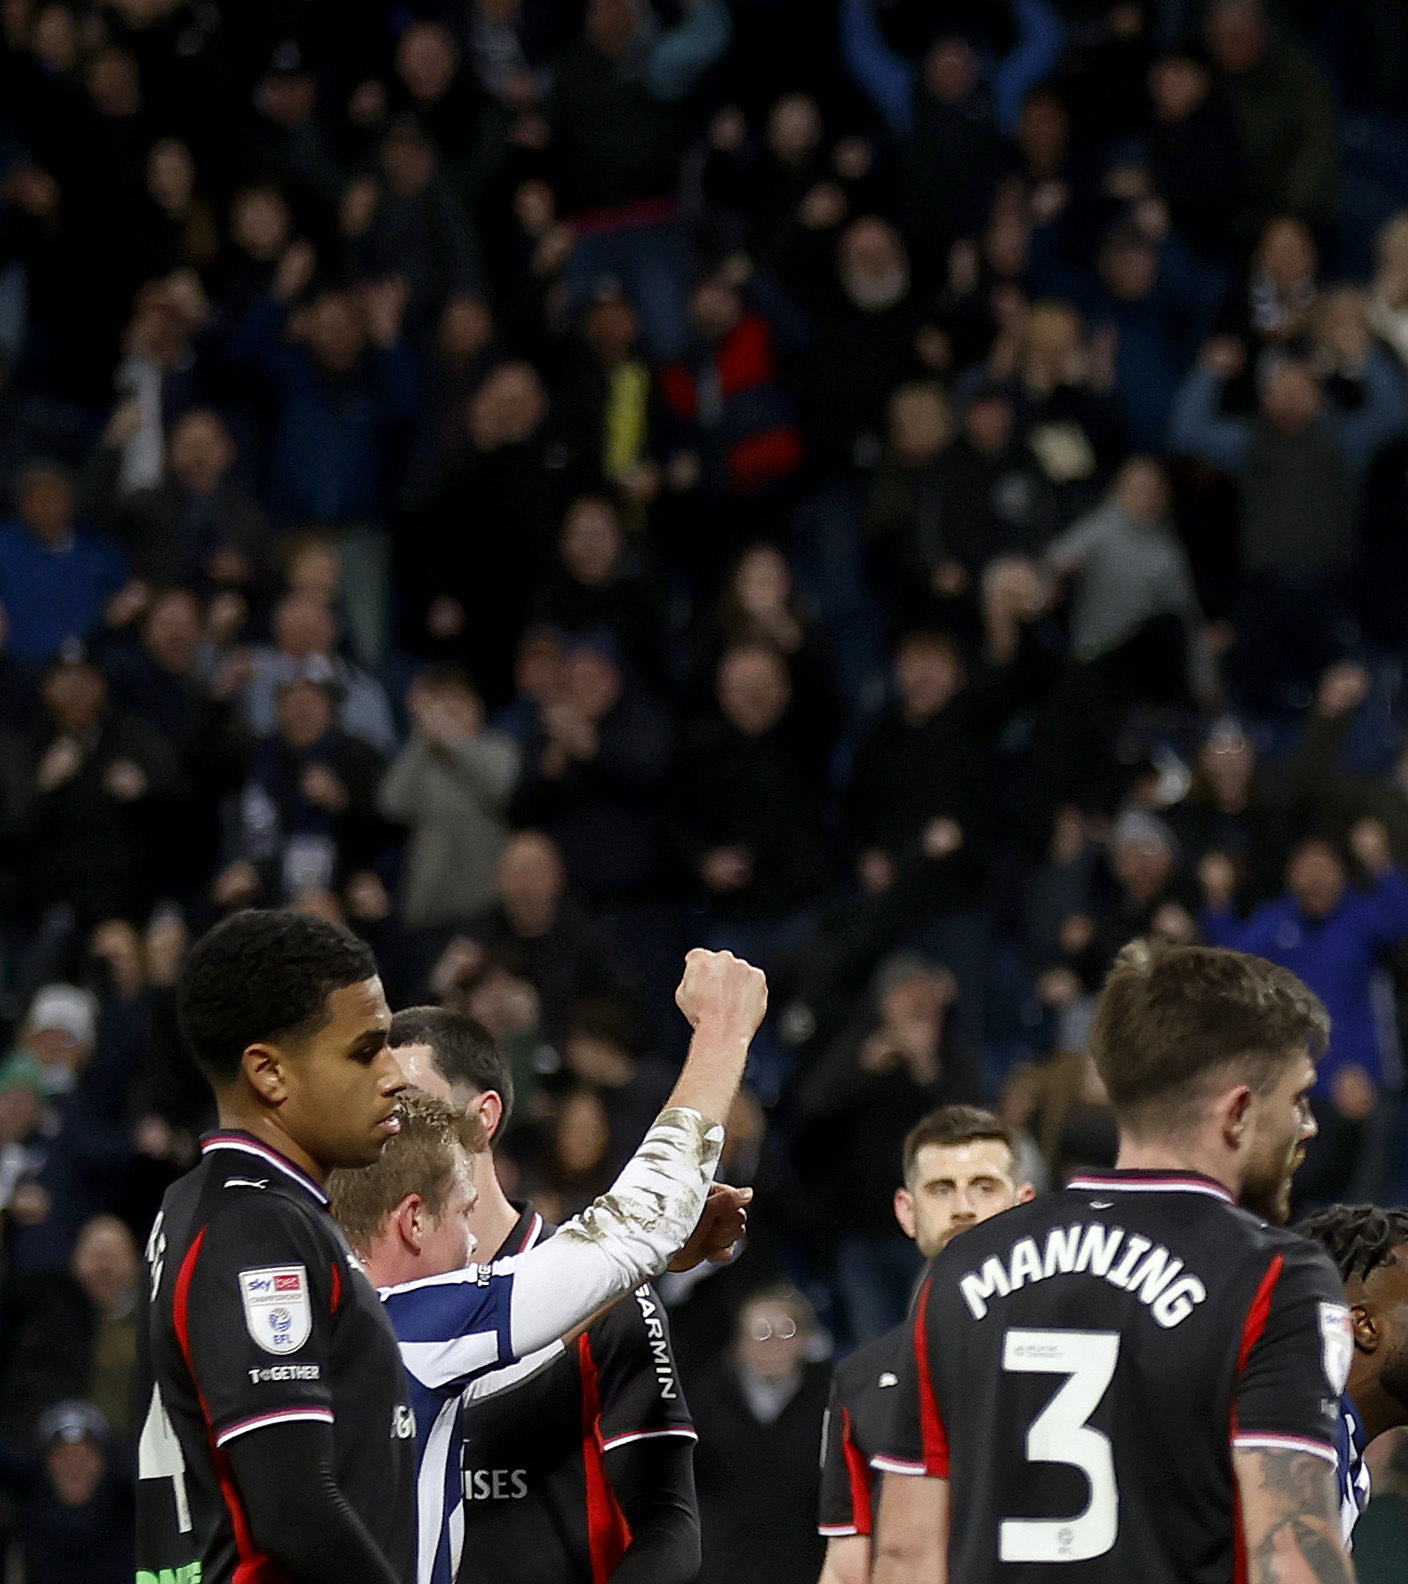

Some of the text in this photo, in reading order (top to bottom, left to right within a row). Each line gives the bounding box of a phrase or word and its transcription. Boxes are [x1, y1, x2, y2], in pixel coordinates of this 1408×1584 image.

[958, 1224, 1208, 1330] MANNING
[248, 1364, 321, 1385] TOGETHER
[999, 1326, 1121, 1564] 3
[460, 1468, 529, 1501] ISES
